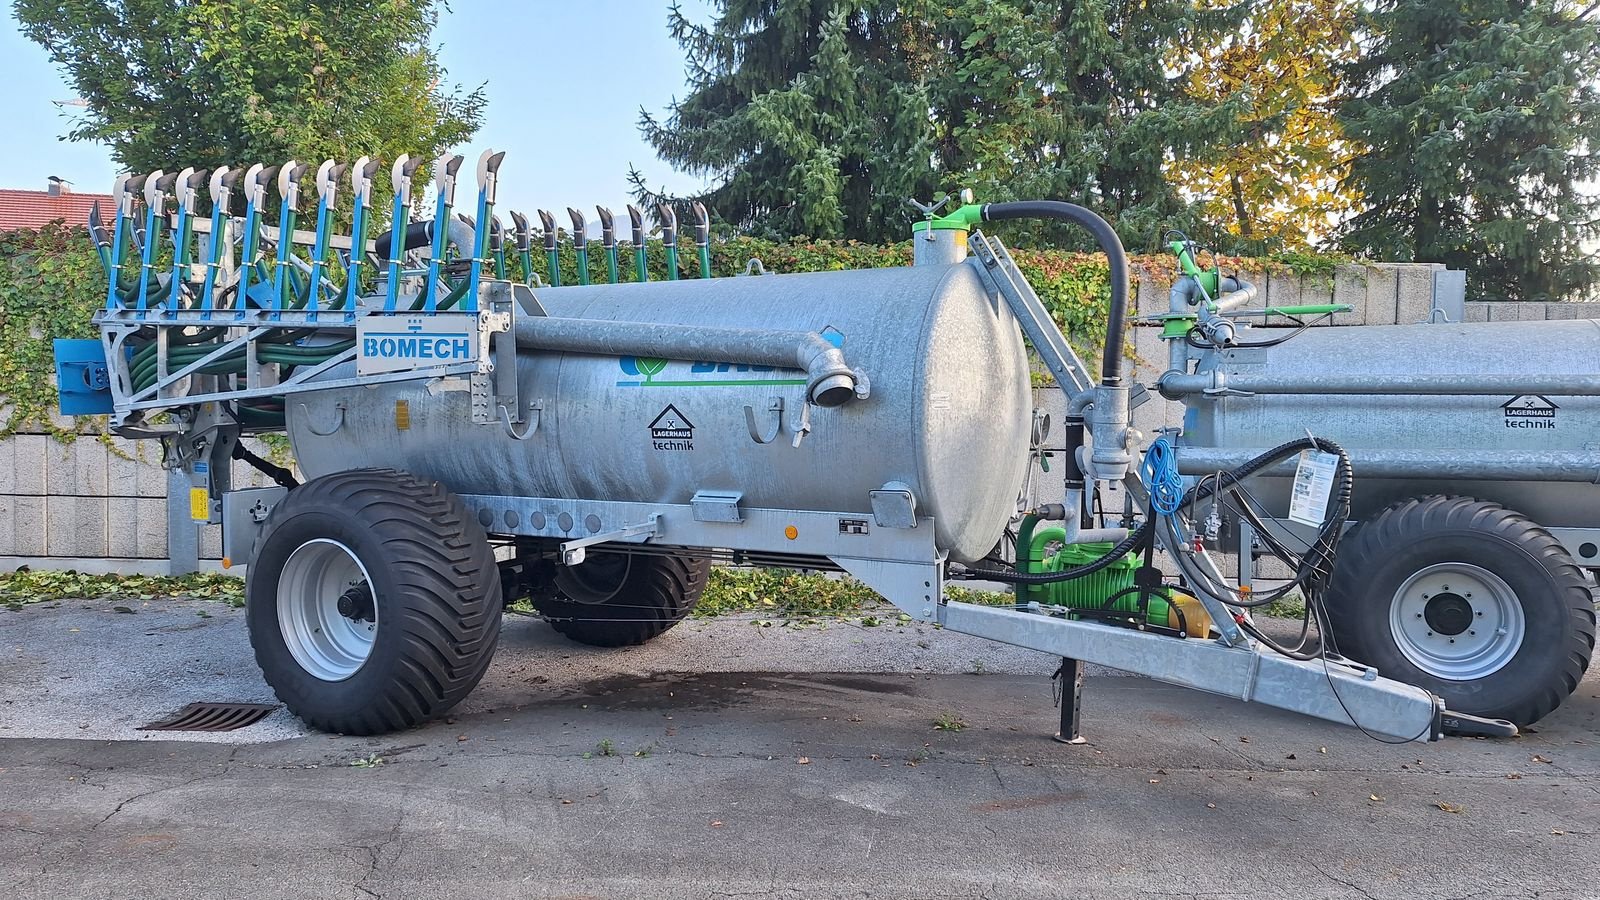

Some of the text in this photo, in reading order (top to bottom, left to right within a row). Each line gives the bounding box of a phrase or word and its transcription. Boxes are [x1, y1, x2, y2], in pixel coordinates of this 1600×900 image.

[363, 338, 469, 359] BOMECH
[1505, 418, 1555, 429] technik
[653, 430, 691, 438] LAGERHAUS
[652, 440, 694, 451] technik
